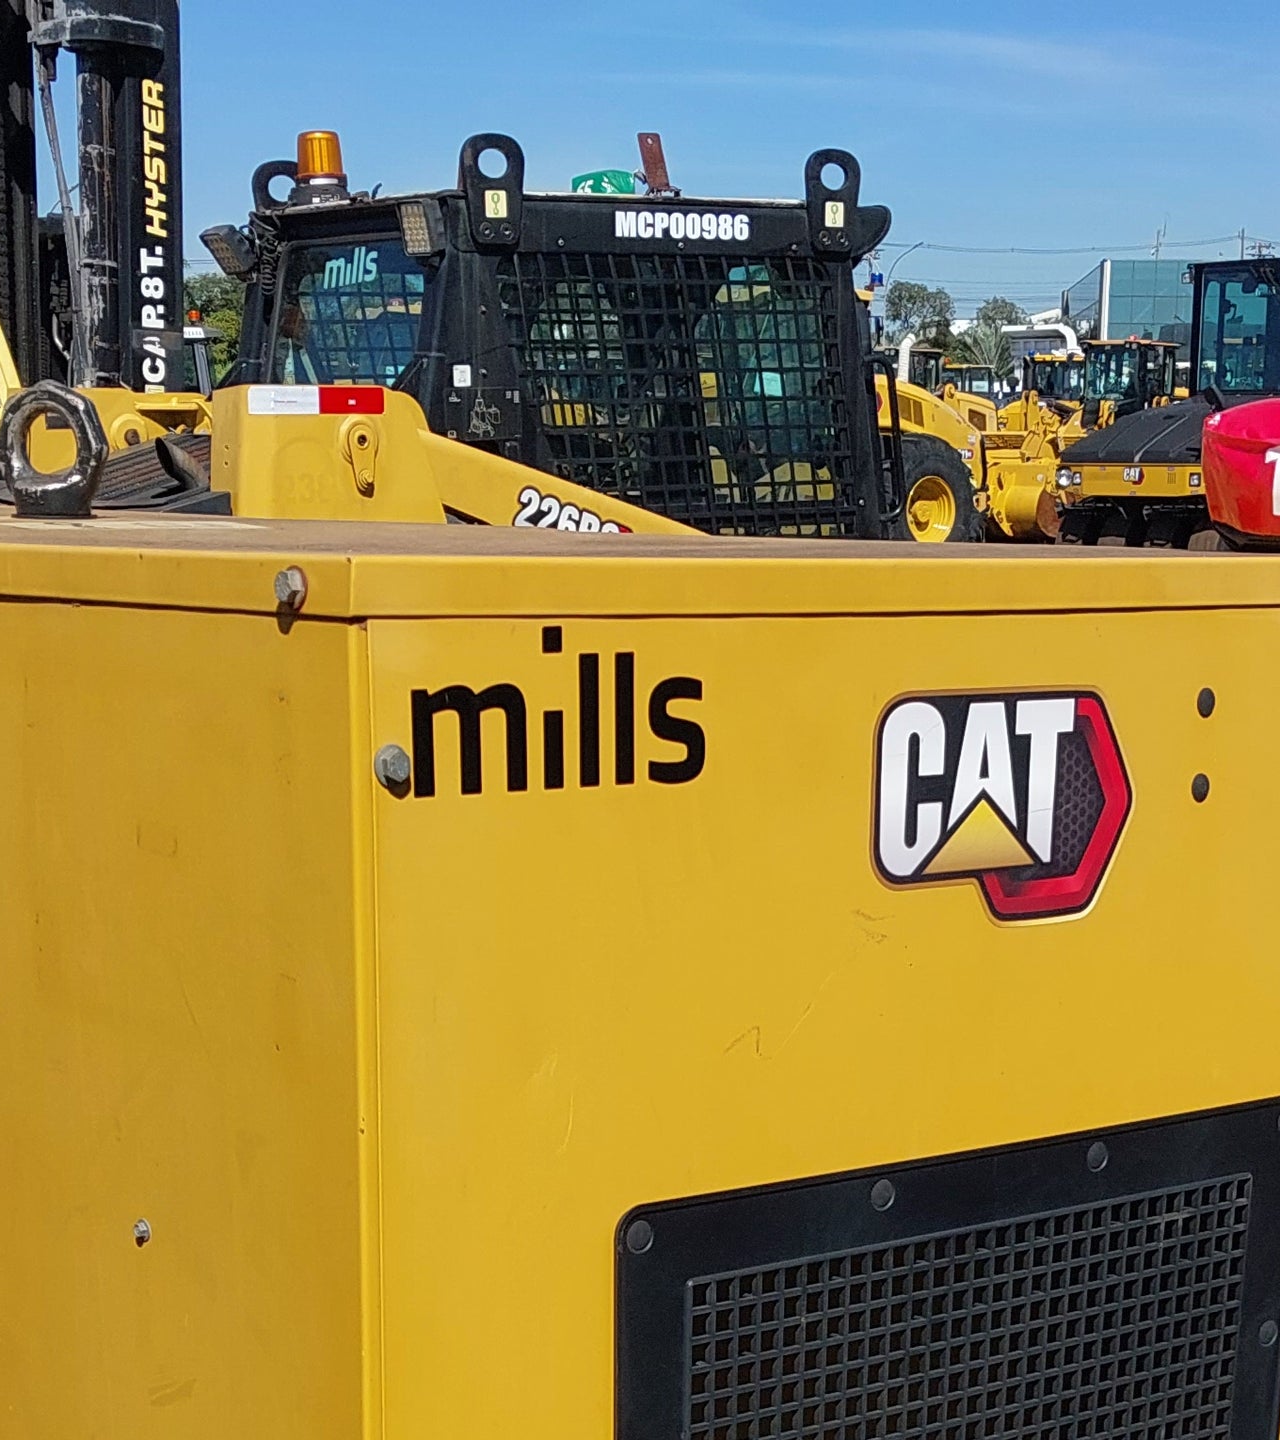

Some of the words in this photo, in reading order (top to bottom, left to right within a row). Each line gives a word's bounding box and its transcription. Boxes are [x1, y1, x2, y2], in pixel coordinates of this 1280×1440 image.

[141, 78, 167, 238] HYSTER
[323, 246, 378, 290] mills
[615, 211, 750, 240] MCP00986
[1124, 467, 1140, 482] CAT
[411, 625, 706, 798] mills
[879, 698, 1076, 877] CAT
